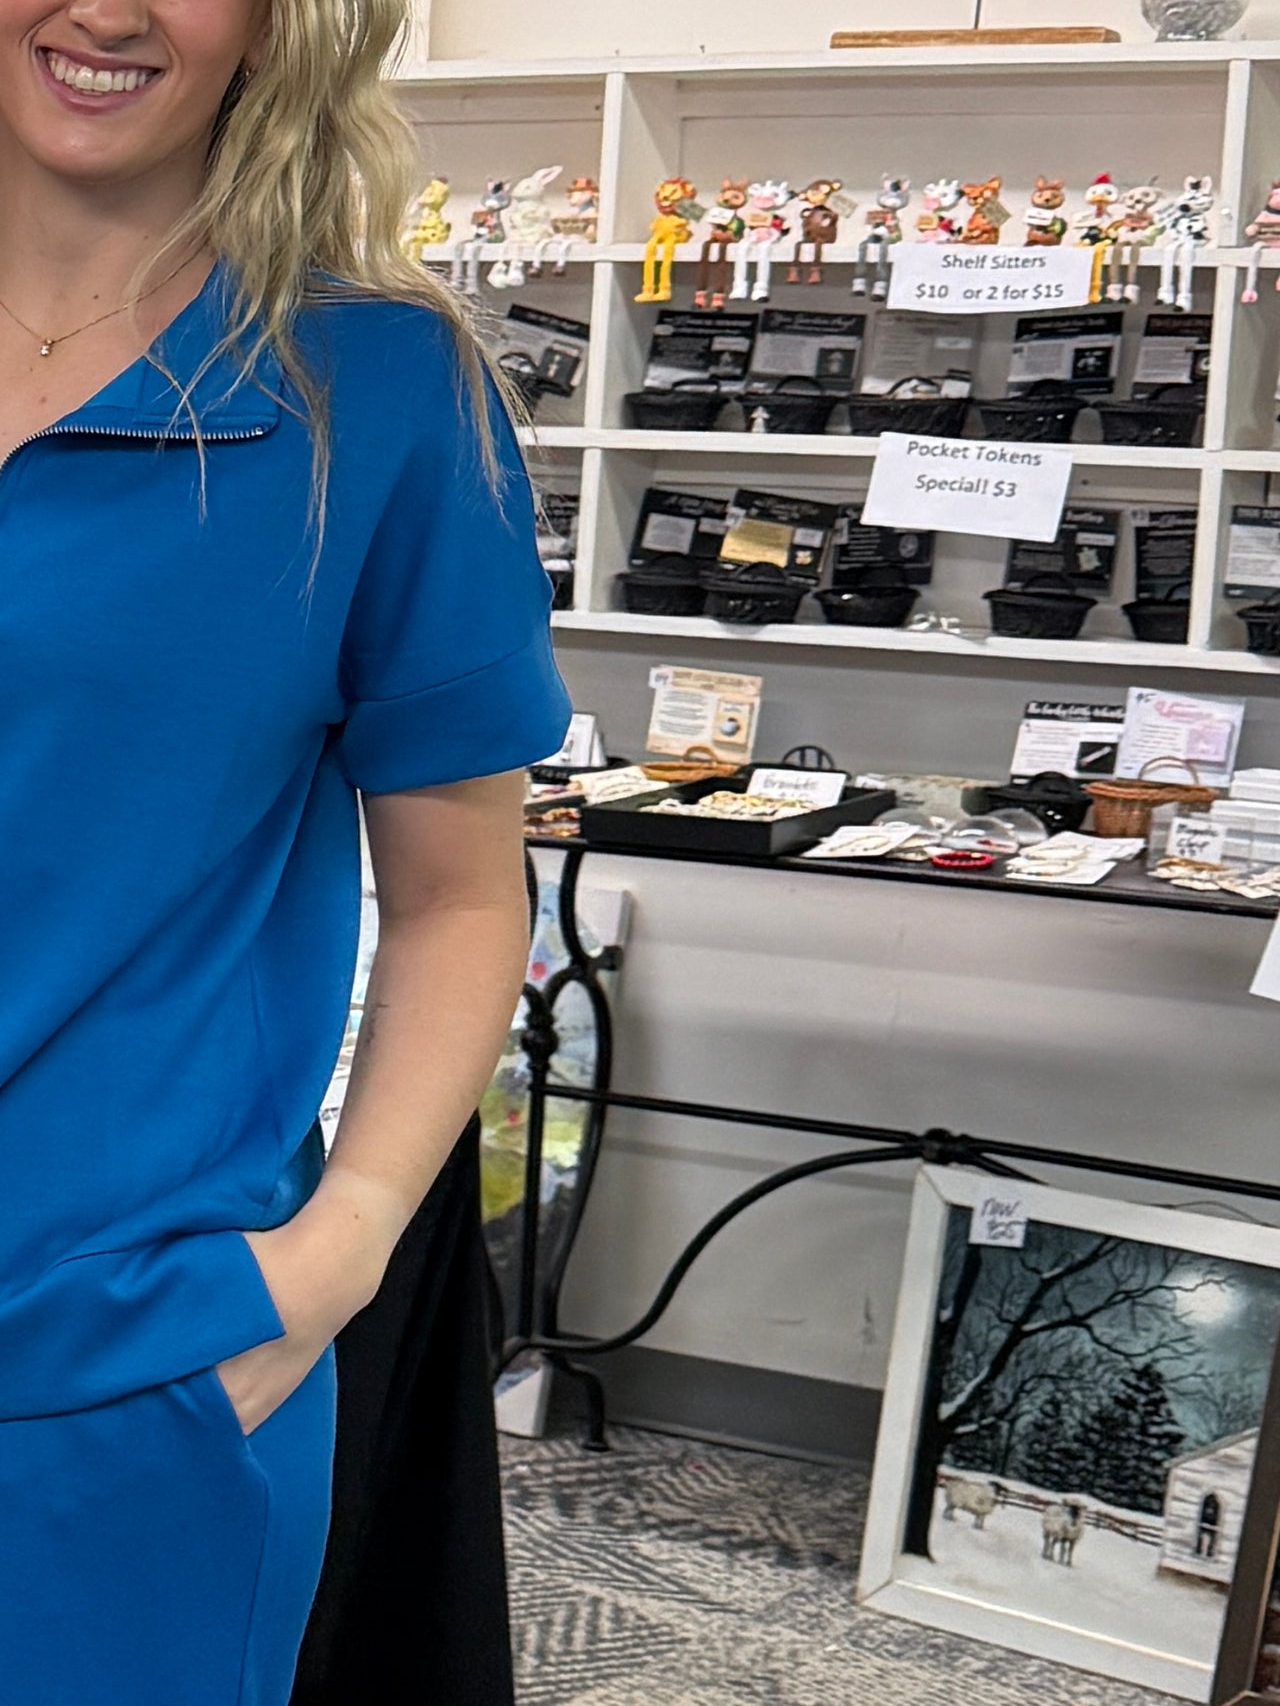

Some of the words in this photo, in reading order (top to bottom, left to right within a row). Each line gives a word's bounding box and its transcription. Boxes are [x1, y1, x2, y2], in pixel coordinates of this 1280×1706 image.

[942, 254, 988, 269] Shelf
[990, 255, 1047, 269] Sitters
[915, 283, 949, 299] $10
[963, 289, 983, 299] or
[985, 286, 999, 300] 2
[1002, 285, 1028, 300] for
[1032, 284, 1064, 300] $15
[907, 441, 970, 460] Pocket
[976, 446, 1043, 466] Tokens
[992, 480, 1018, 497] $3
